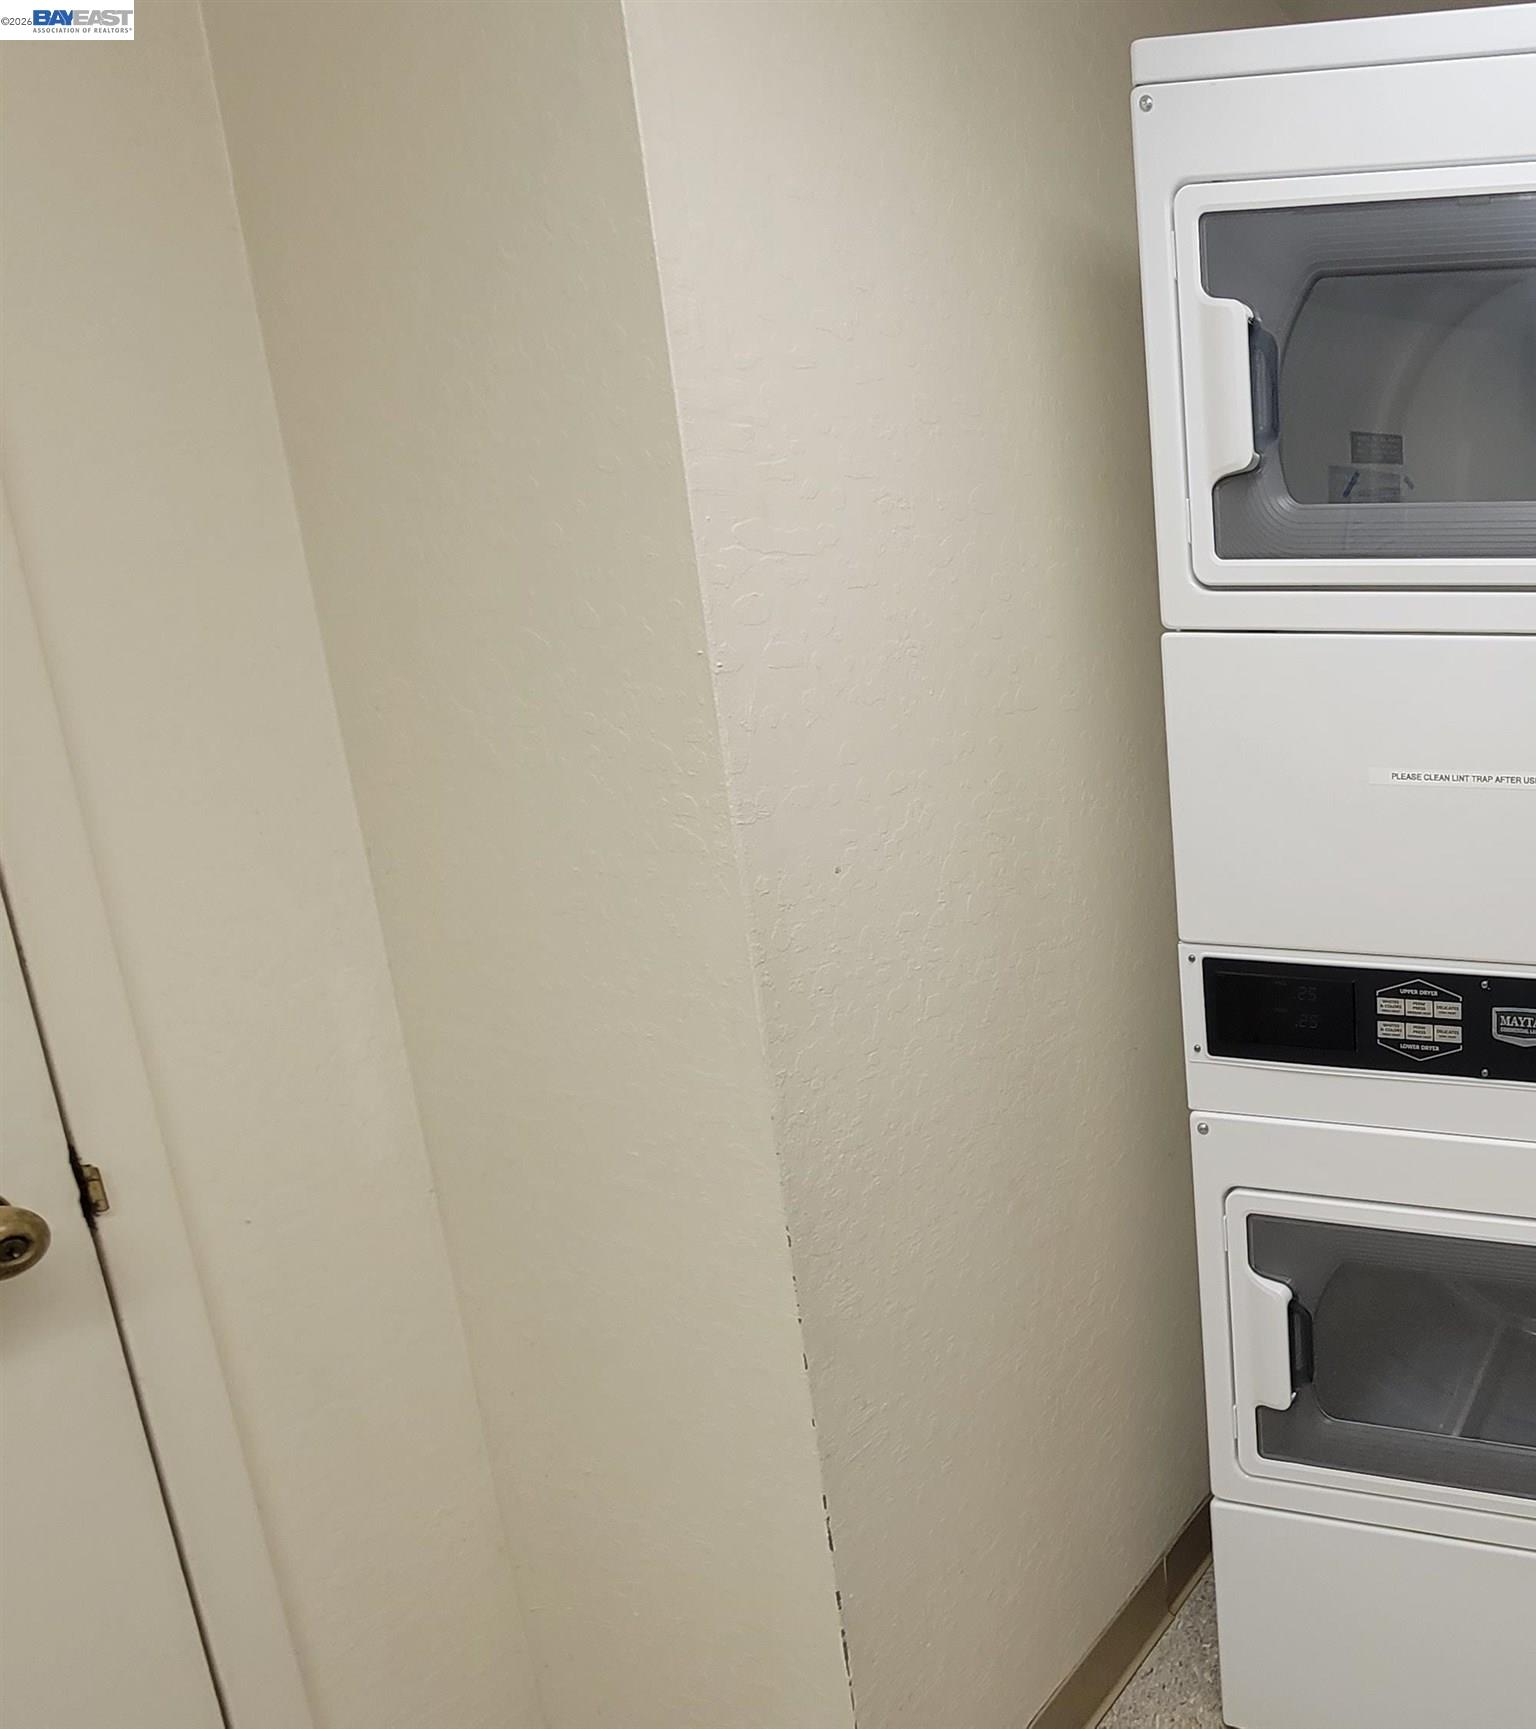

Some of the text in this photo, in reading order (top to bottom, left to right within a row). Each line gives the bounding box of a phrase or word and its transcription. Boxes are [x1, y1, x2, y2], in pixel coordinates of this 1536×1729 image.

[1391, 773, 1422, 781] PLEASE
[1423, 773, 1450, 782] CLEAN
[1452, 774, 1469, 783] LINT
[1471, 775, 1493, 783] TRAP
[1495, 776, 1522, 784] AFTER
